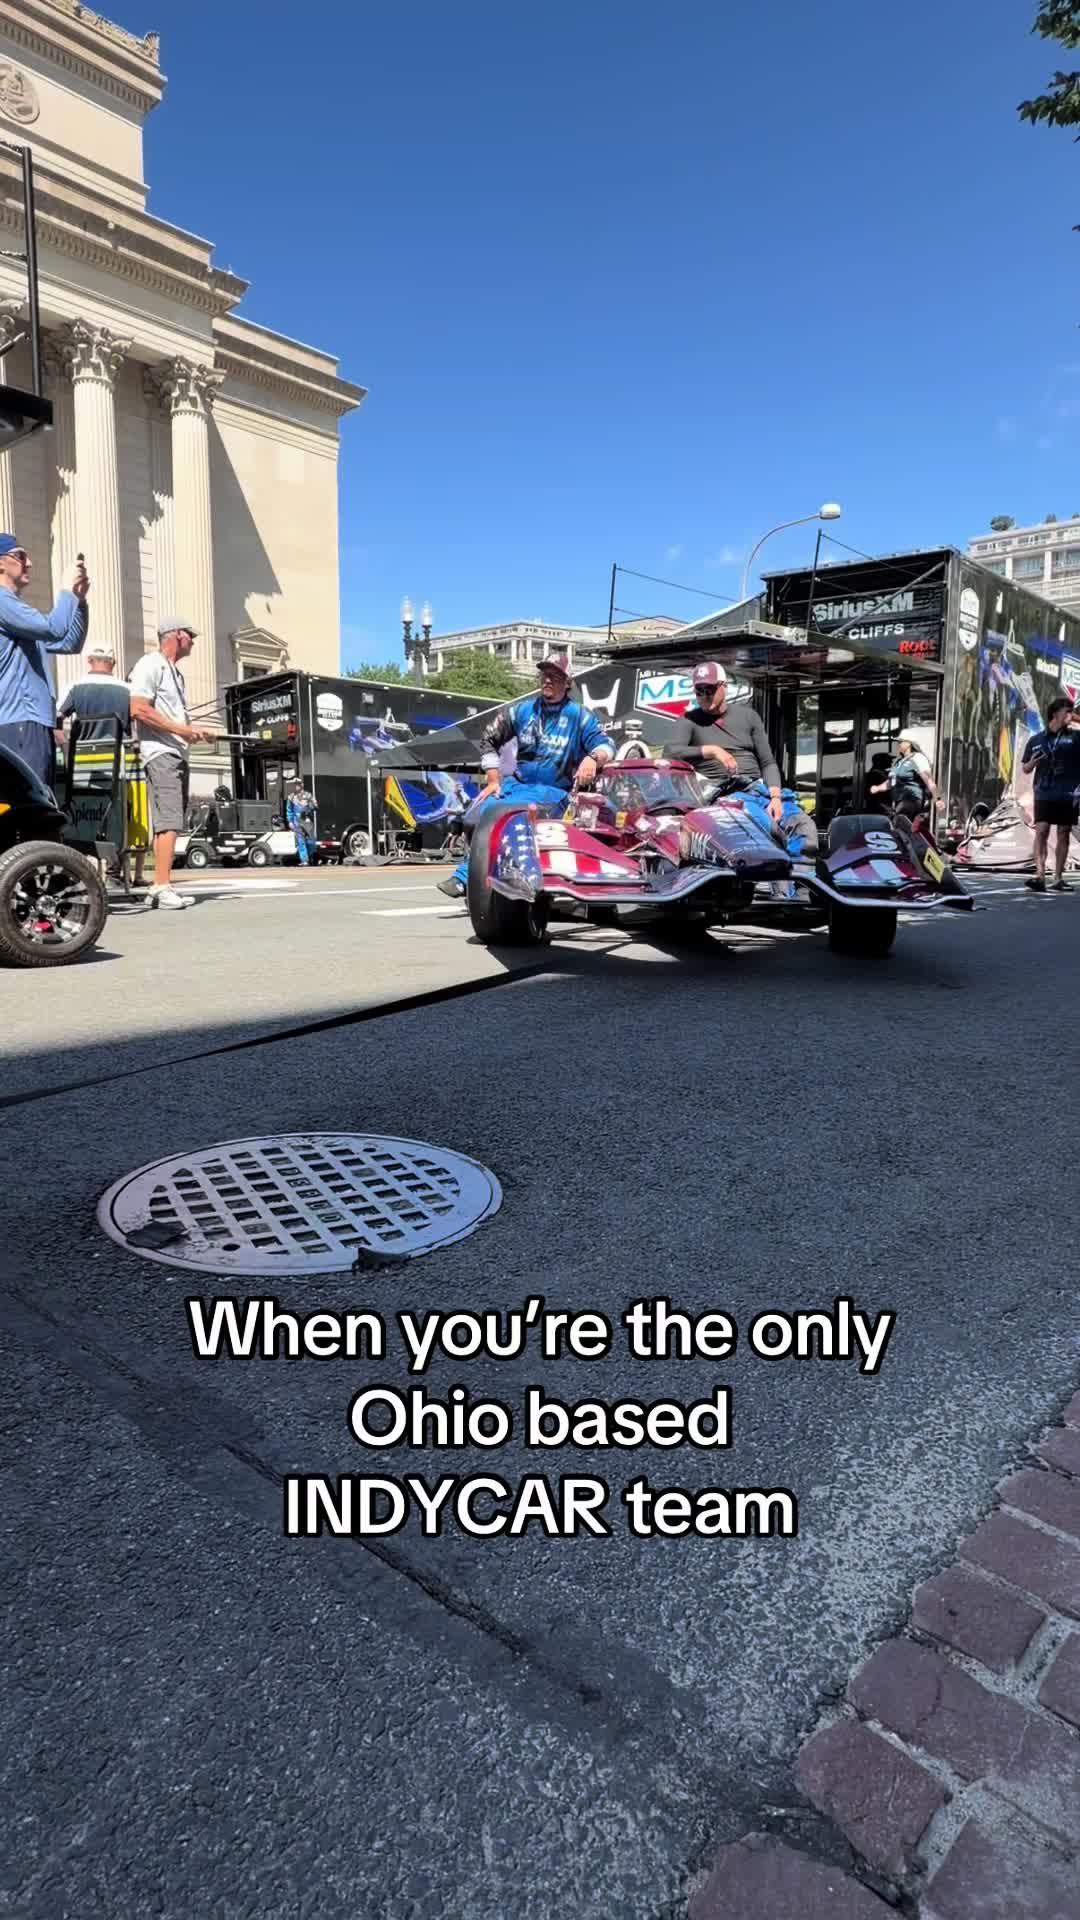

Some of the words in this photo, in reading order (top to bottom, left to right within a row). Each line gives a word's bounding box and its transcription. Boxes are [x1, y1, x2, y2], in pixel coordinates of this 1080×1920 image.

[813, 592, 914, 622] SiriusXM
[848, 623, 905, 640] CLIFFS
[640, 679, 696, 701] MS
[251, 694, 292, 713] SiriusXM
